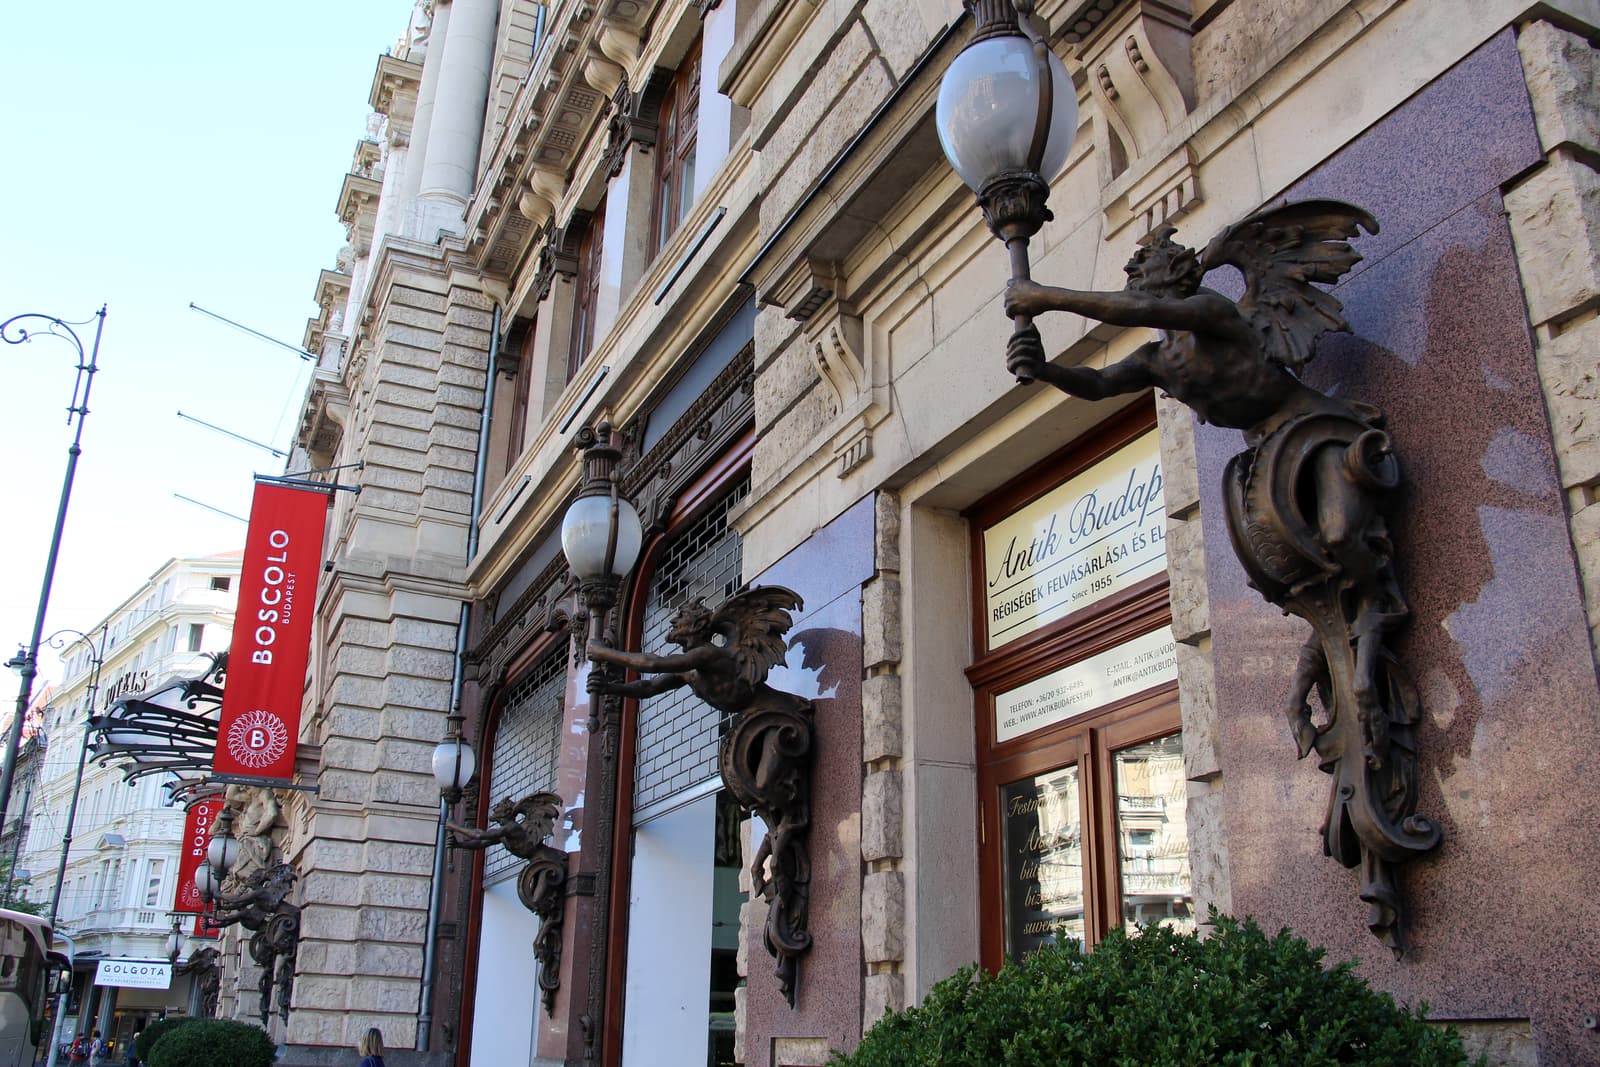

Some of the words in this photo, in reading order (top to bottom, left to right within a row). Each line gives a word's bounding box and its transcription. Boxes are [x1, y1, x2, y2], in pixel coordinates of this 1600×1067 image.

[989, 514, 1062, 587] Antik
[252, 529, 289, 665] BOSCOLO
[282, 572, 296, 624] BUDAPEST
[993, 585, 1044, 622] RÉGISÉGEK
[1047, 543, 1128, 595] FELVÁSÁRLÁSA
[1132, 532, 1146, 552] ÉS
[1071, 588, 1089, 602] Since
[1090, 575, 1113, 594] 1955
[1009, 699, 1034, 713] TELEFON:
[1020, 687, 1093, 722] WWW.ANTIKBUDAPEST.HU
[251, 730, 265, 748] B
[193, 801, 209, 856] BOSCO
[104, 964, 165, 976] GOLGOTA
